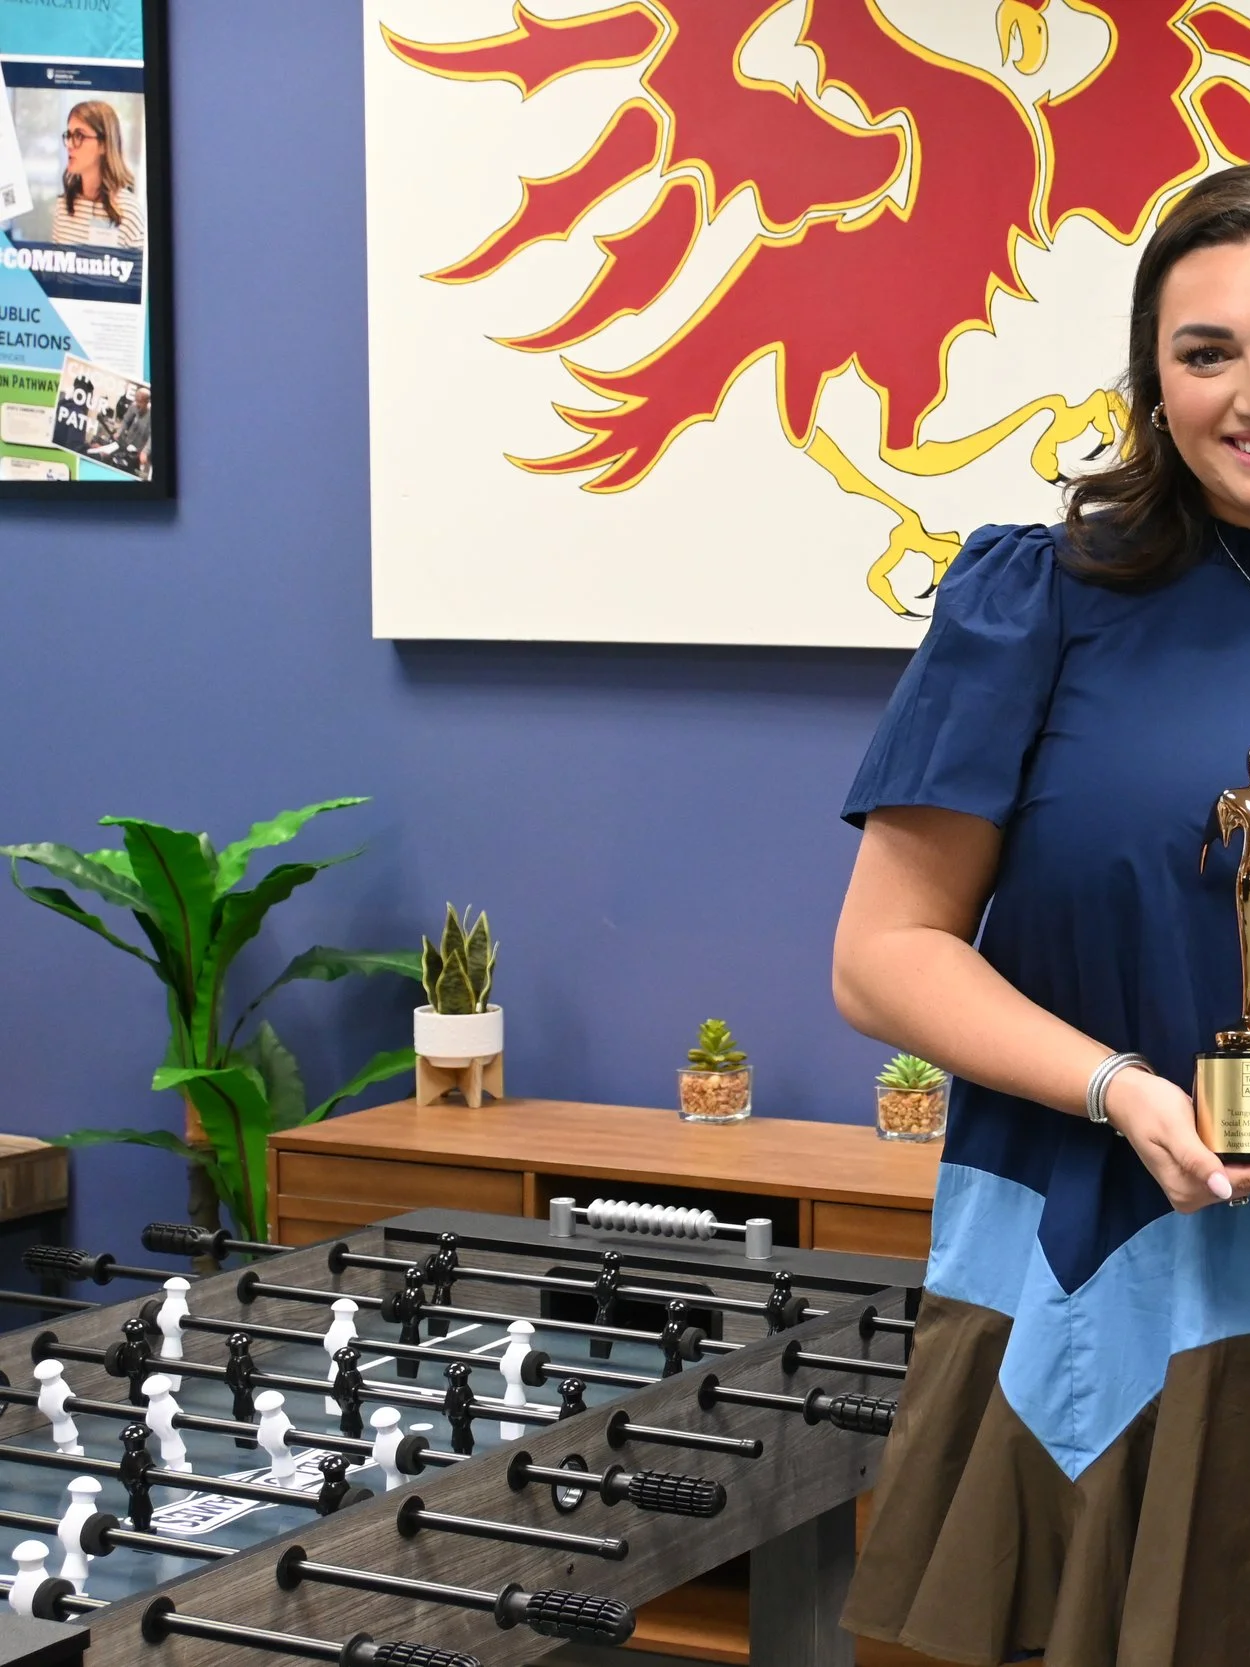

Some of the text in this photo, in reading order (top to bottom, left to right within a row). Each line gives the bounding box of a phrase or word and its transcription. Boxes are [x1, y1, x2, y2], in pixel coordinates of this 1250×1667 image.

[0, 247, 134, 283] COMMunity
[64, 387, 109, 415] YOUR
[58, 406, 99, 436] PATH
[153, 1496, 243, 1527] AMES
